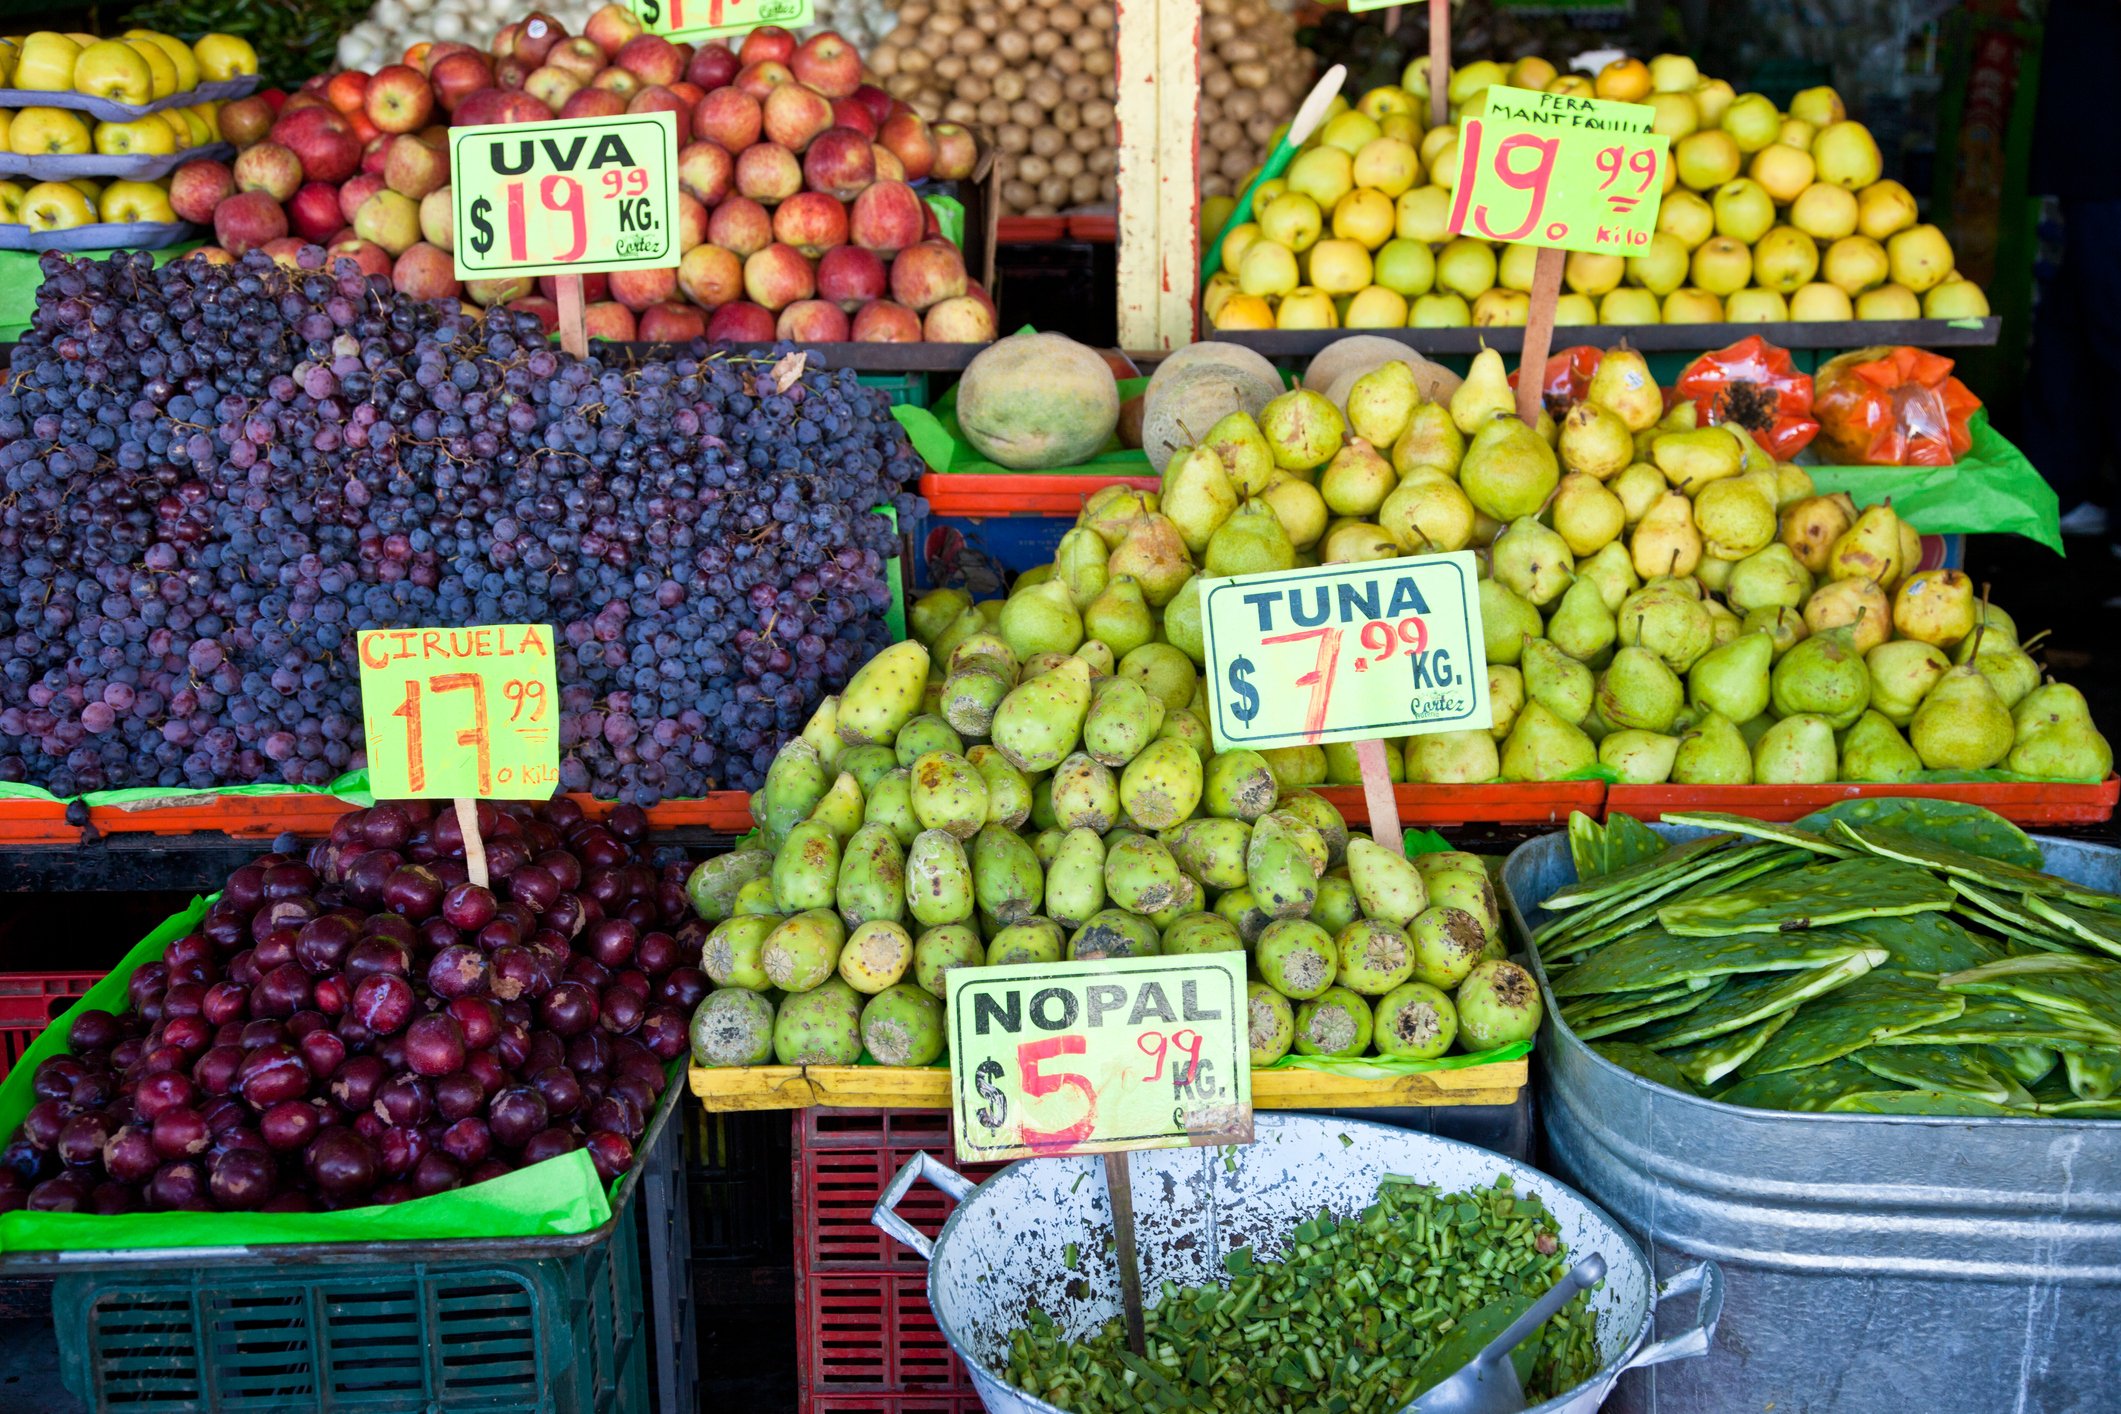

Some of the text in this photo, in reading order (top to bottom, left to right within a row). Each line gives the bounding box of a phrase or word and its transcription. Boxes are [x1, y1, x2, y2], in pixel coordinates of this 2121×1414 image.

[1541, 94, 1595, 112] PERA
[490, 134, 636, 175] UVA
[619, 198, 659, 232] KG.
[616, 237, 659, 256] Cortez
[1244, 577, 1431, 631] TUNA
[360, 626, 547, 669] CIRUELA
[1411, 649, 1462, 689] KG.
[1411, 695, 1464, 717] Cortez
[973, 979, 1222, 1035] NOPAL
[1172, 1058, 1226, 1101] KG.
